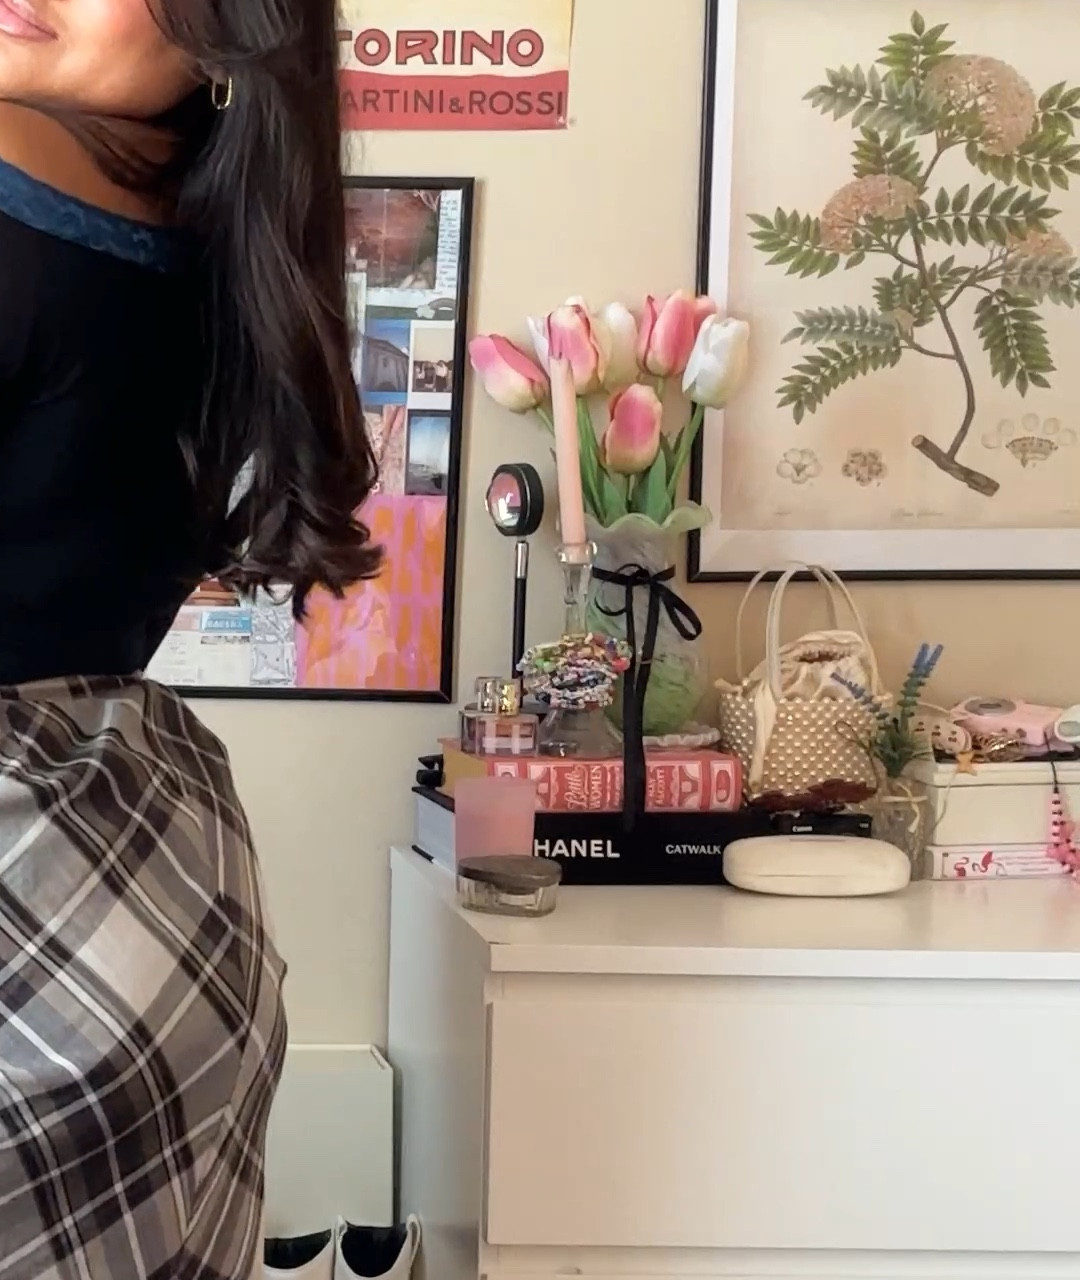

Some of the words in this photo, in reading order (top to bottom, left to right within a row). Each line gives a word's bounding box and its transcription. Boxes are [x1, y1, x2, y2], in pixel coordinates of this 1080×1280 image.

[590, 765, 602, 810] WOMEN
[533, 838, 621, 858] HANEL
[665, 844, 722, 855] CATWALK
